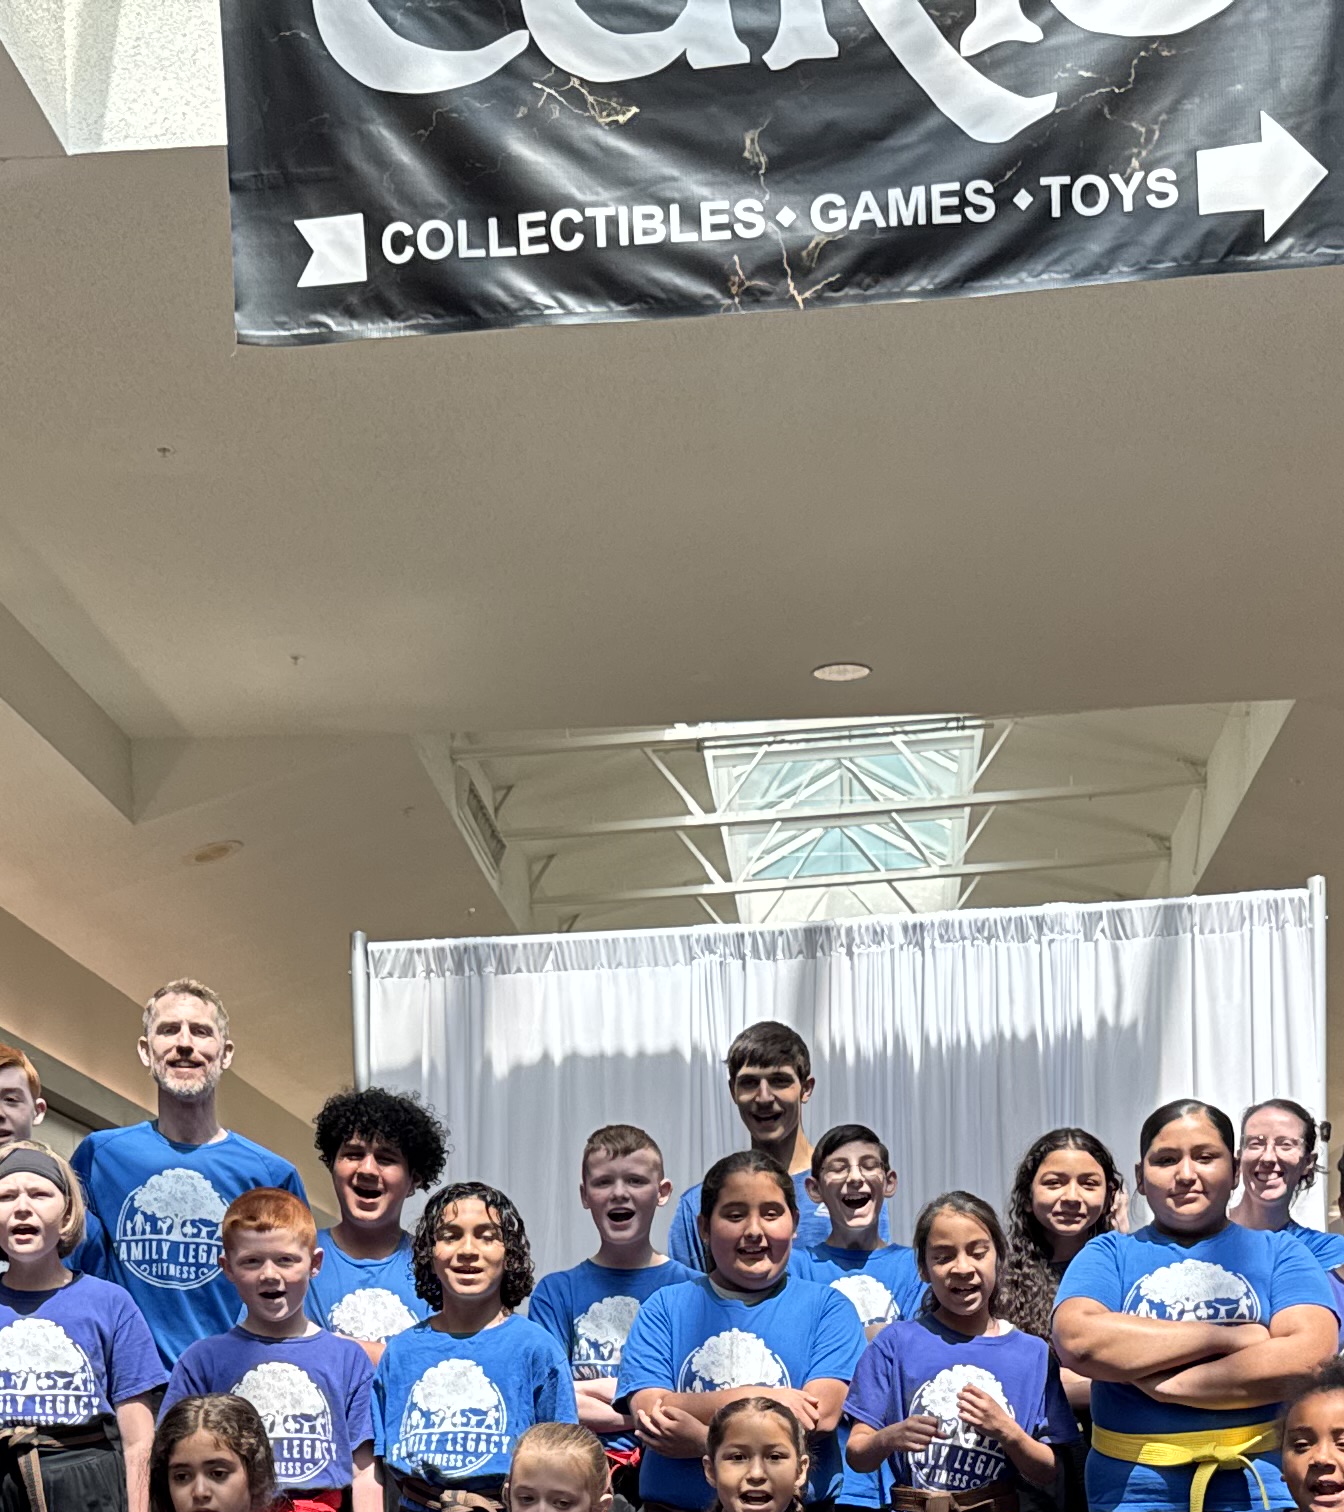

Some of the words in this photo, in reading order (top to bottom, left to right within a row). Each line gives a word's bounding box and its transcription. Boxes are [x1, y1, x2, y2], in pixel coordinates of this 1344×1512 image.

[380, 201, 765, 267] COLLECTIBLES
[810, 180, 997, 234] GAMES
[1045, 168, 1180, 218] TOYS
[114, 1240, 170, 1261] AMILY
[152, 1262, 197, 1280] FITNESS
[35, 1395, 100, 1416] LEGACY
[283, 1440, 337, 1461] LEGACY
[447, 1432, 511, 1453] LEGACY
[273, 1461, 301, 1475] NESS
